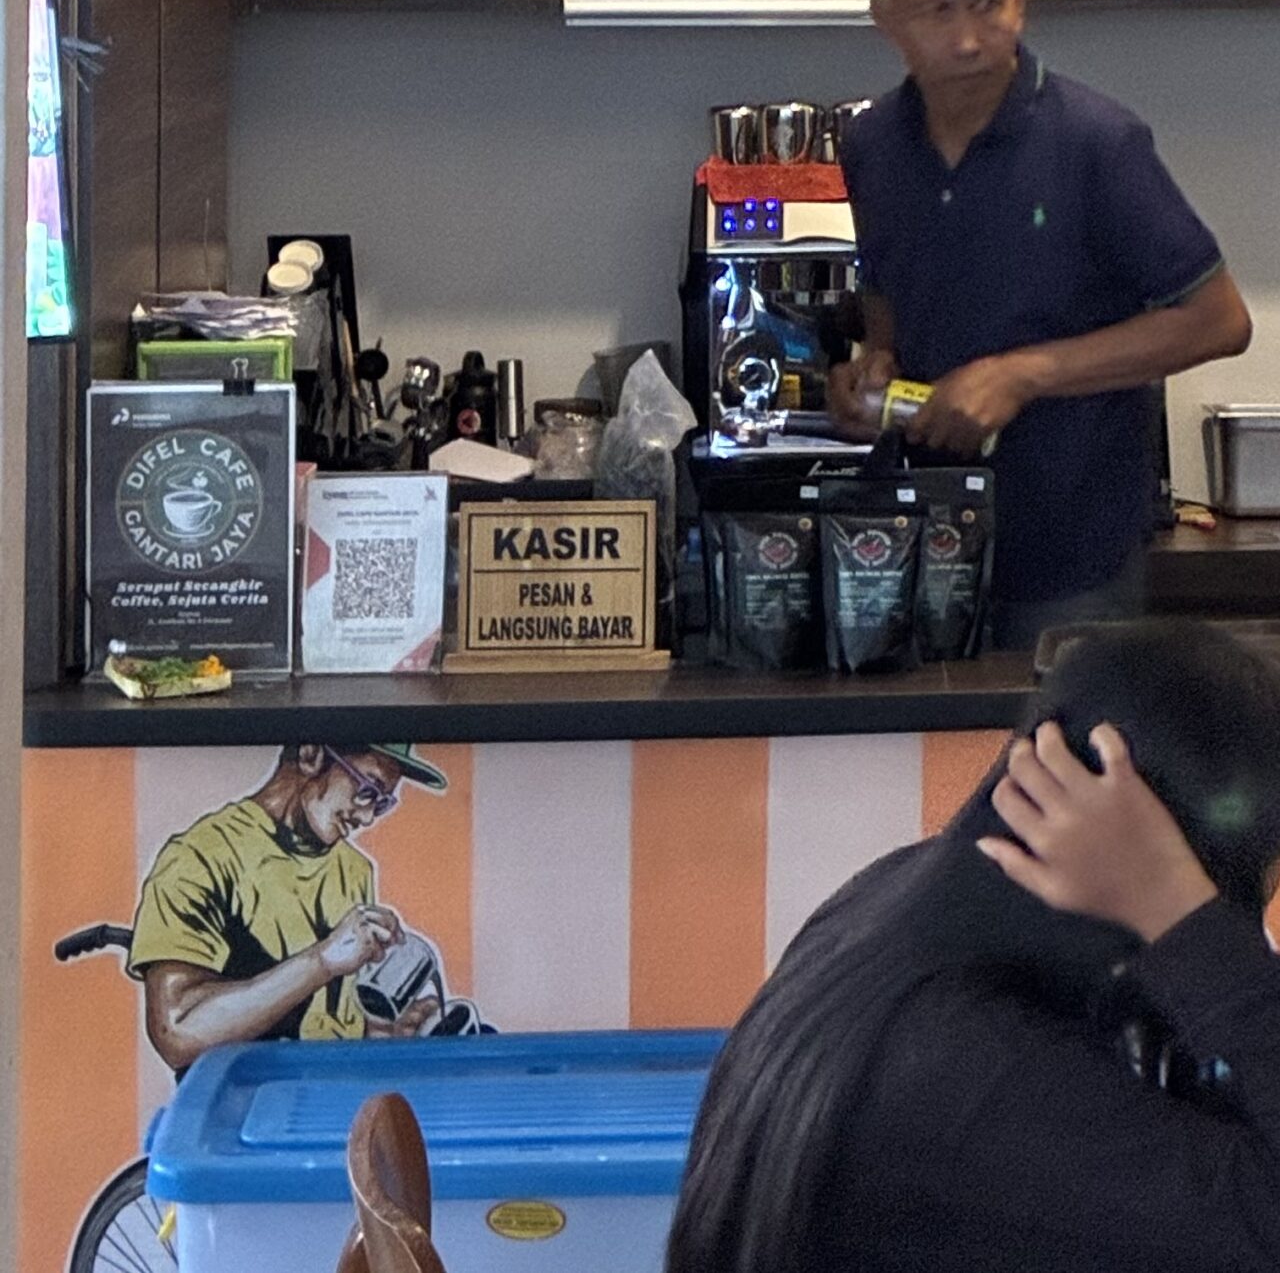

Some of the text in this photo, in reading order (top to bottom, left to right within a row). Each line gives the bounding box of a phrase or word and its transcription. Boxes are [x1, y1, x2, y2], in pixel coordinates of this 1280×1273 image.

[126, 437, 255, 491] DIFEL CAFE
[210, 511, 255, 562] JAYA
[493, 527, 621, 561] KASIR
[116, 578, 263, 595] Seruput Secangkir
[519, 582, 593, 607] PESAN &
[168, 594, 217, 607] Sejuta
[221, 593, 269, 606] Cerita
[478, 615, 634, 641] LANGSUNG BAYAR
